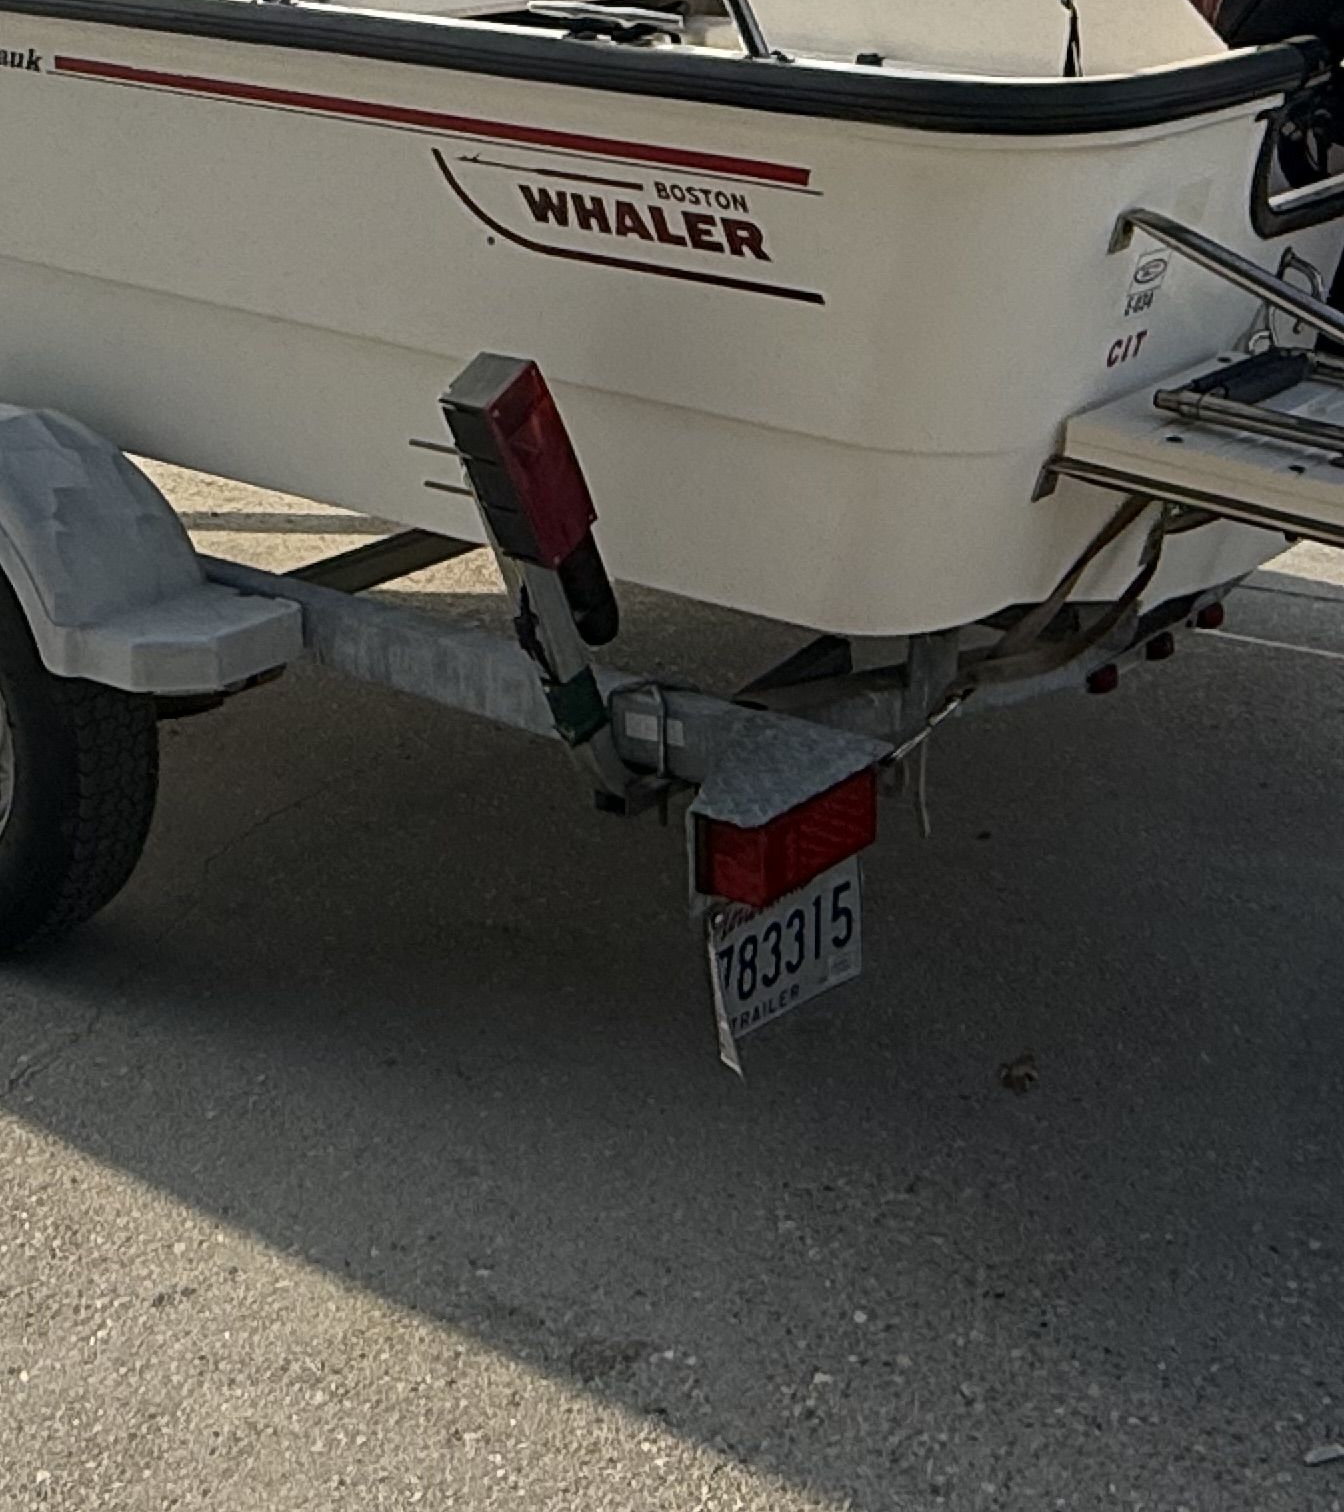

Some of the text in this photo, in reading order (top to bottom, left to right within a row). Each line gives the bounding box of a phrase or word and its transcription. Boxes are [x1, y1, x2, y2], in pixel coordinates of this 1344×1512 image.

[519, 184, 773, 263] WHALER
[654, 181, 750, 214] BOSTON
[718, 881, 854, 1000] 783315
